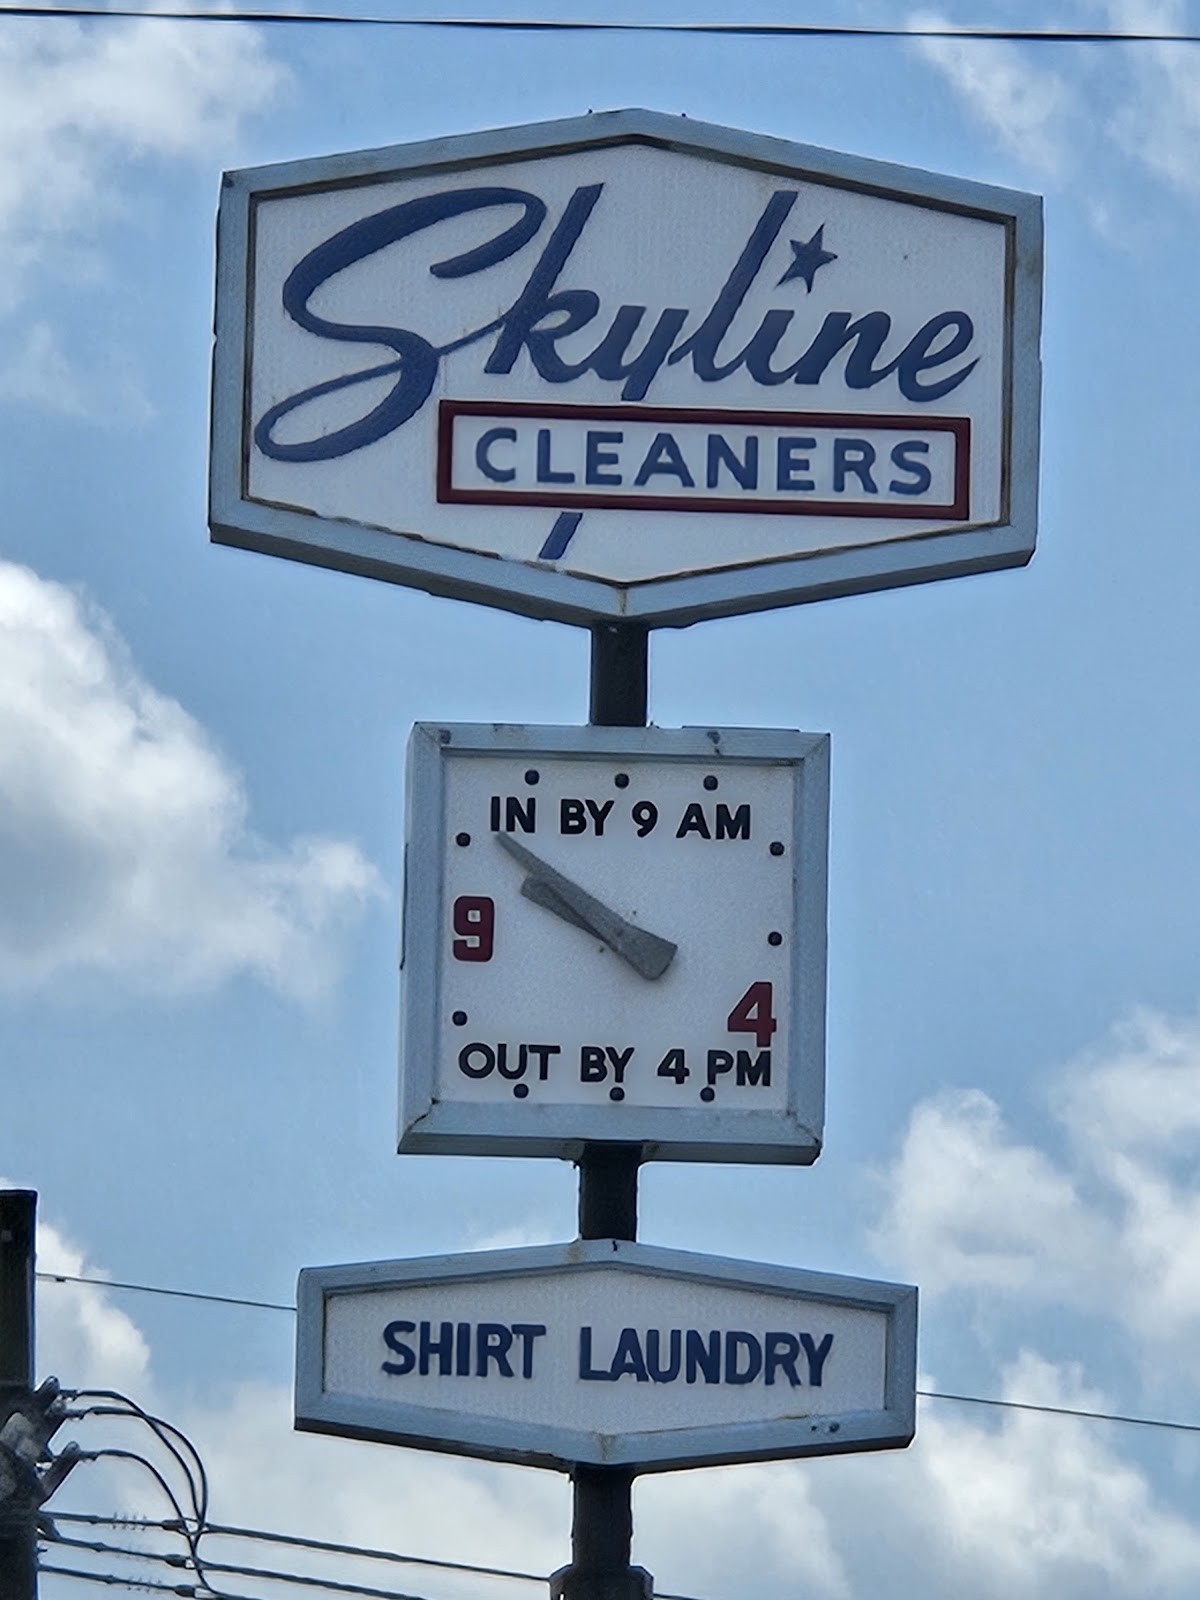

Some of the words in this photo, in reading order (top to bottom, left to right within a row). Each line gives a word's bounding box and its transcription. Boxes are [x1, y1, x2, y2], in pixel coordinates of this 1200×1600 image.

[253, 181, 982, 560] Skyline
[476, 426, 932, 496] CLEANERS
[490, 796, 536, 834] IN
[560, 799, 615, 836] BY
[632, 801, 658, 838] 9
[676, 803, 751, 840] AM
[452, 895, 495, 962] 9
[727, 981, 777, 1048] 4
[458, 1042, 561, 1081] OUT
[580, 1046, 635, 1083] BY
[657, 1048, 690, 1085] 4
[707, 1050, 772, 1087] PM
[380, 1320, 547, 1380] SHIRT
[578, 1326, 834, 1388] LAUNDRY
